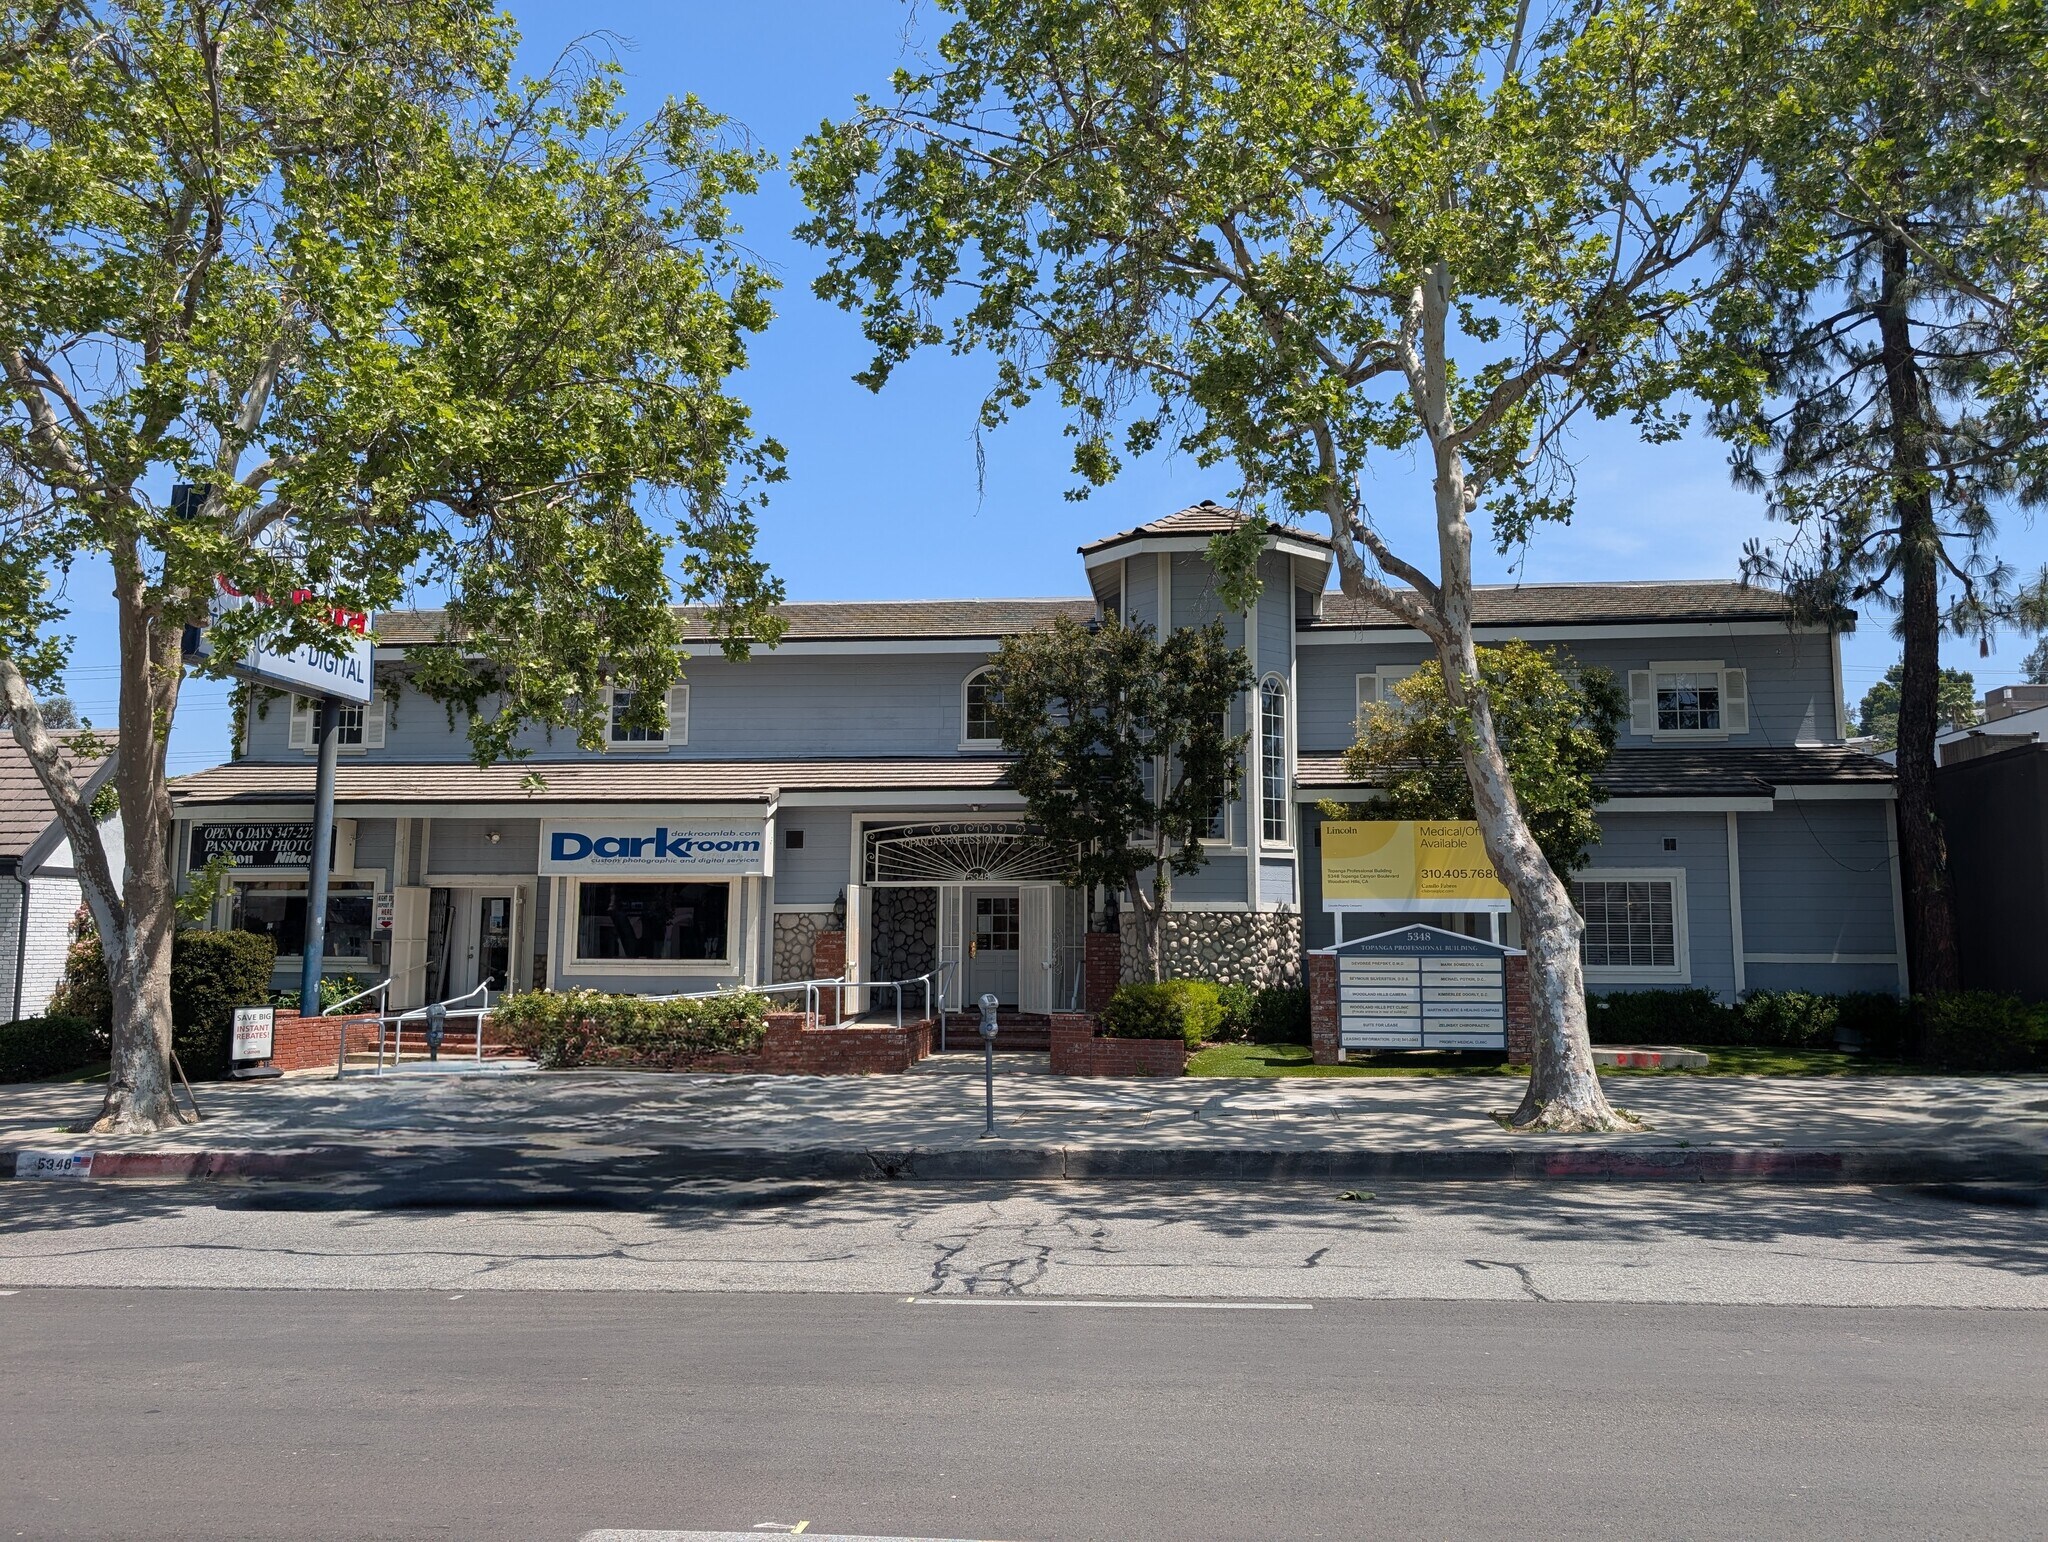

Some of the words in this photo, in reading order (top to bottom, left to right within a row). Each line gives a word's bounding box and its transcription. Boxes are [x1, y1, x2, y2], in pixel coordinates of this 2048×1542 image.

[308, 645, 364, 684] DIGITAL
[204, 827, 235, 839] OPEN
[236, 827, 244, 839] 6
[245, 827, 273, 839] DAYS
[1326, 826, 1358, 834] Lincoln
[204, 840, 269, 852] PASSPORT
[551, 828, 760, 861] Darkroom
[900, 838, 938, 848] TOPANGA
[941, 836, 1009, 846] PROFESSIONAL
[1420, 838, 1468, 848] Available
[1407, 932, 1431, 940] 5348
[237, 1024, 269, 1032] INSTANT
[236, 1032, 270, 1040] REBATES!
[38, 1157, 72, 1170] 5348
